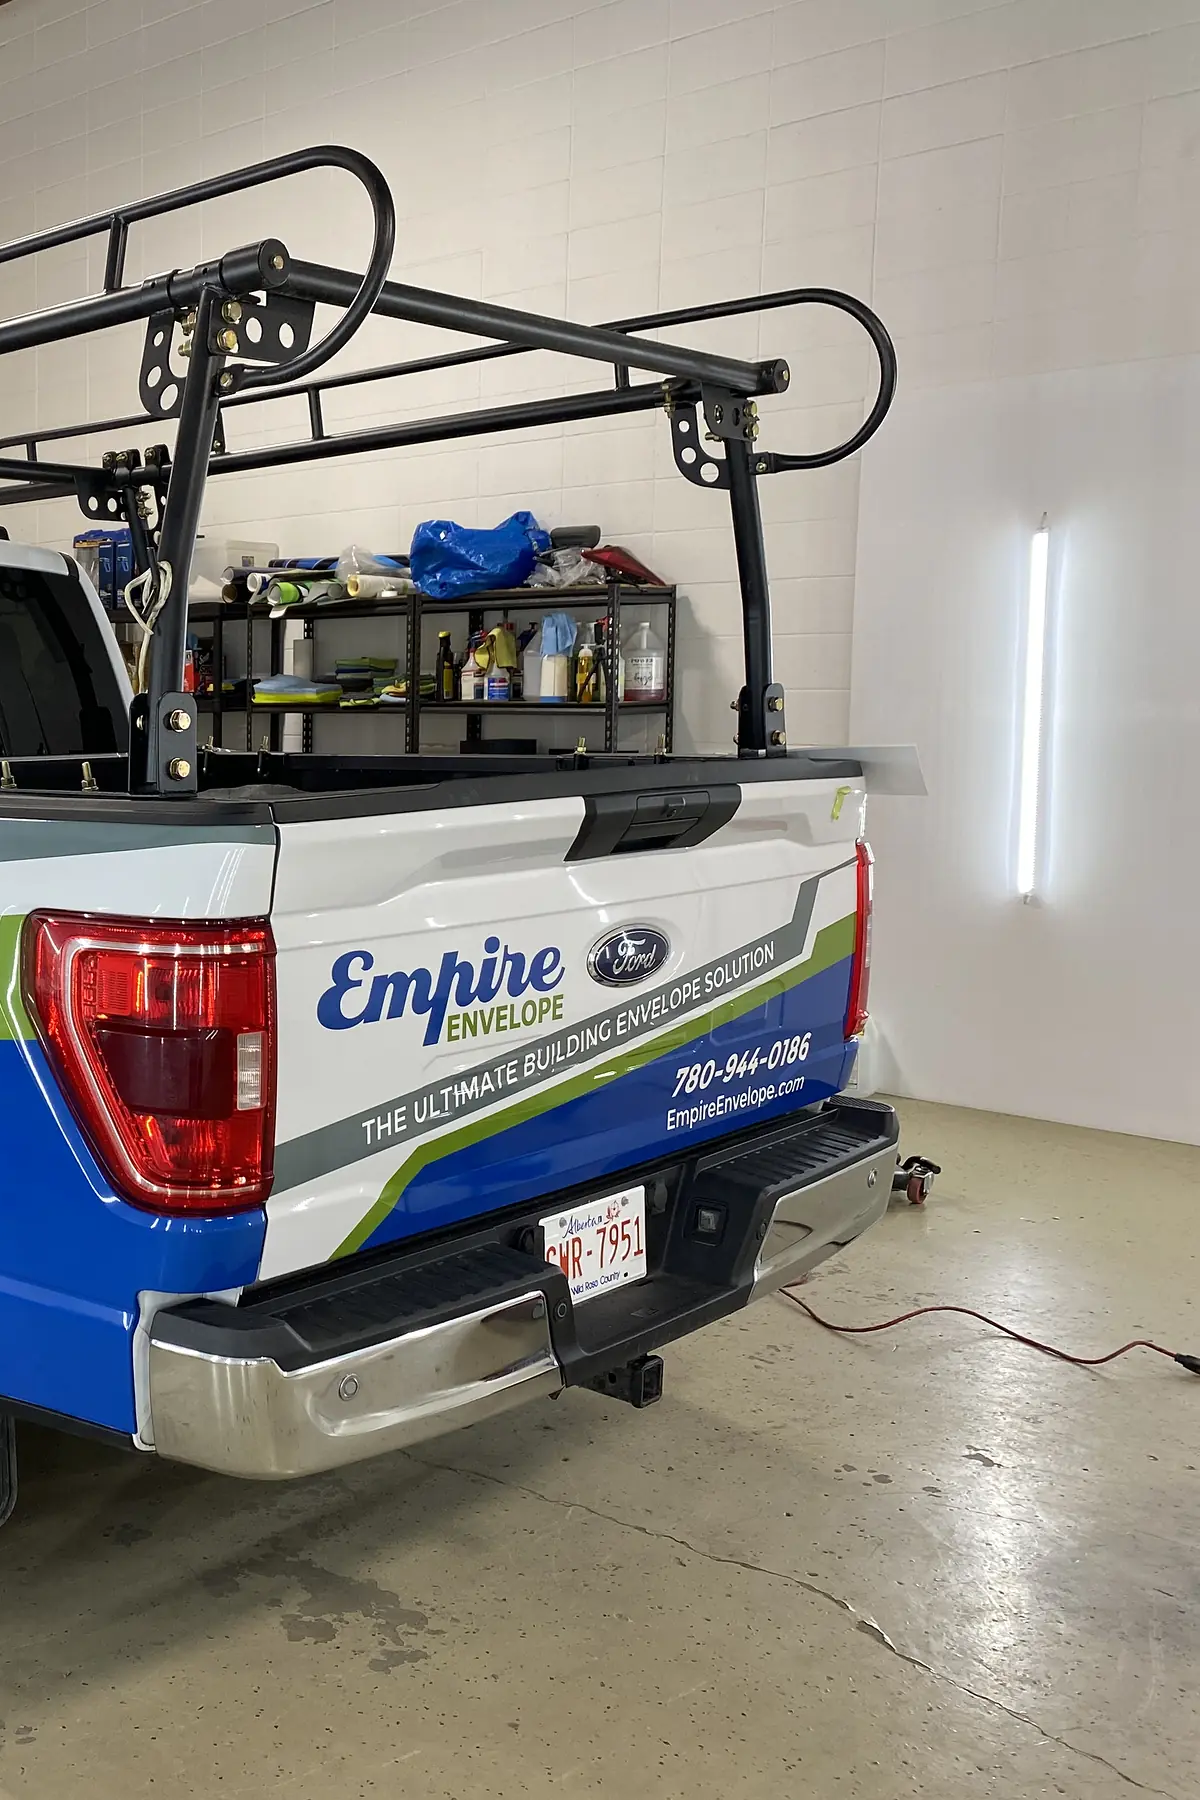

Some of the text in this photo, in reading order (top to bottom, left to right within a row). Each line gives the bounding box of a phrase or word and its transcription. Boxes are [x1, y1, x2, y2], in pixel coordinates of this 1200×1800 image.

[612, 936, 657, 976] Ford
[316, 935, 566, 1047] Empire
[446, 993, 565, 1043] ENVELOPE
[361, 940, 775, 1145] THE ULTIMATE BUILDING ENVELOPE SOLUTION
[671, 1031, 812, 1098] 780-944-0186
[666, 1075, 805, 1131] EmpireEnvelope.com
[562, 1214, 603, 1239] Alberta
